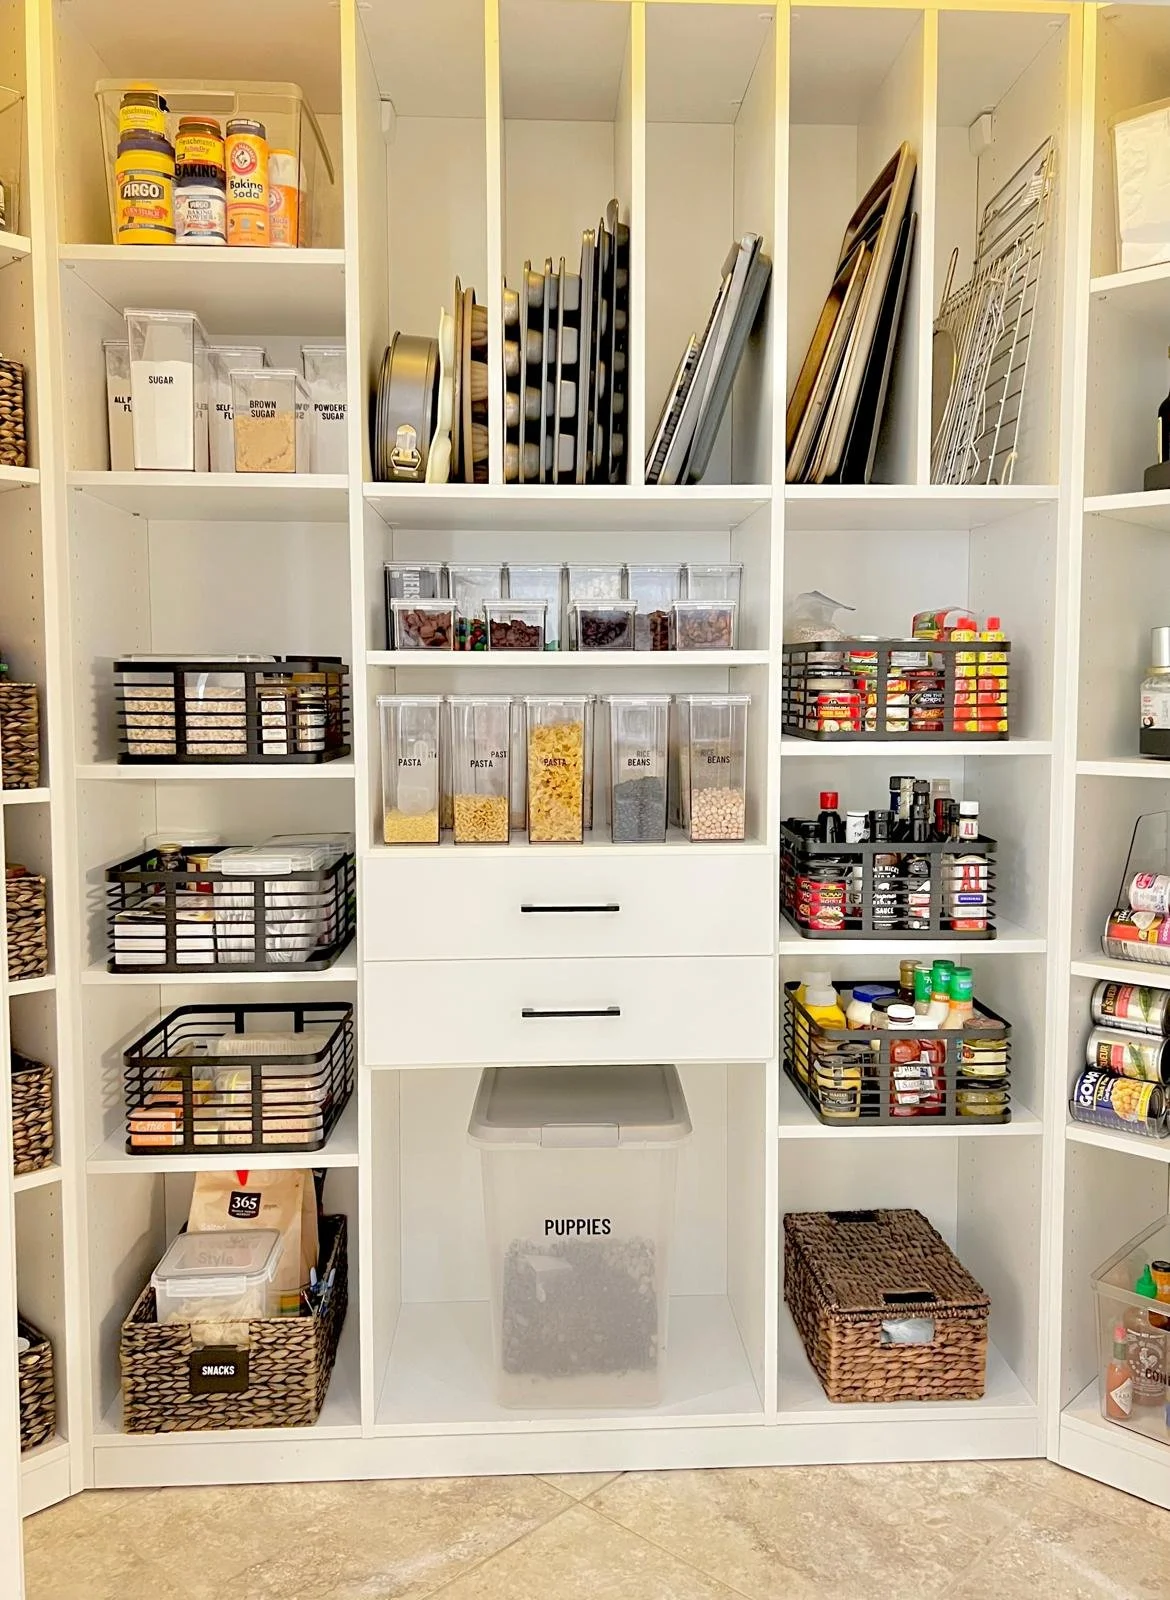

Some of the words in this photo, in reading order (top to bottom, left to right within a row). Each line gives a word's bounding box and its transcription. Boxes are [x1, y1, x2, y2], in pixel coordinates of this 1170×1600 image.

[174, 163, 218, 178] BAKING
[123, 183, 160, 198] ARGO
[230, 179, 263, 193] Baking
[233, 189, 260, 199] Soda
[148, 375, 174, 385] SUGAR
[114, 396, 126, 404] ALL
[249, 400, 277, 409] BROWN
[250, 409, 276, 418] SUGAR
[321, 412, 345, 420] SUGAR
[636, 750, 651, 758] RICE
[398, 758, 422, 767] PASTA
[470, 759, 494, 768] PASTA
[543, 758, 567, 767] PASTA
[627, 758, 651, 767] BEANS
[707, 756, 731, 764] BEANS
[1080, 1071, 1100, 1107] GOYA
[232, 1196, 258, 1210] 365
[544, 1218, 611, 1236] PUPPIES
[201, 1365, 235, 1376] SNACKS
